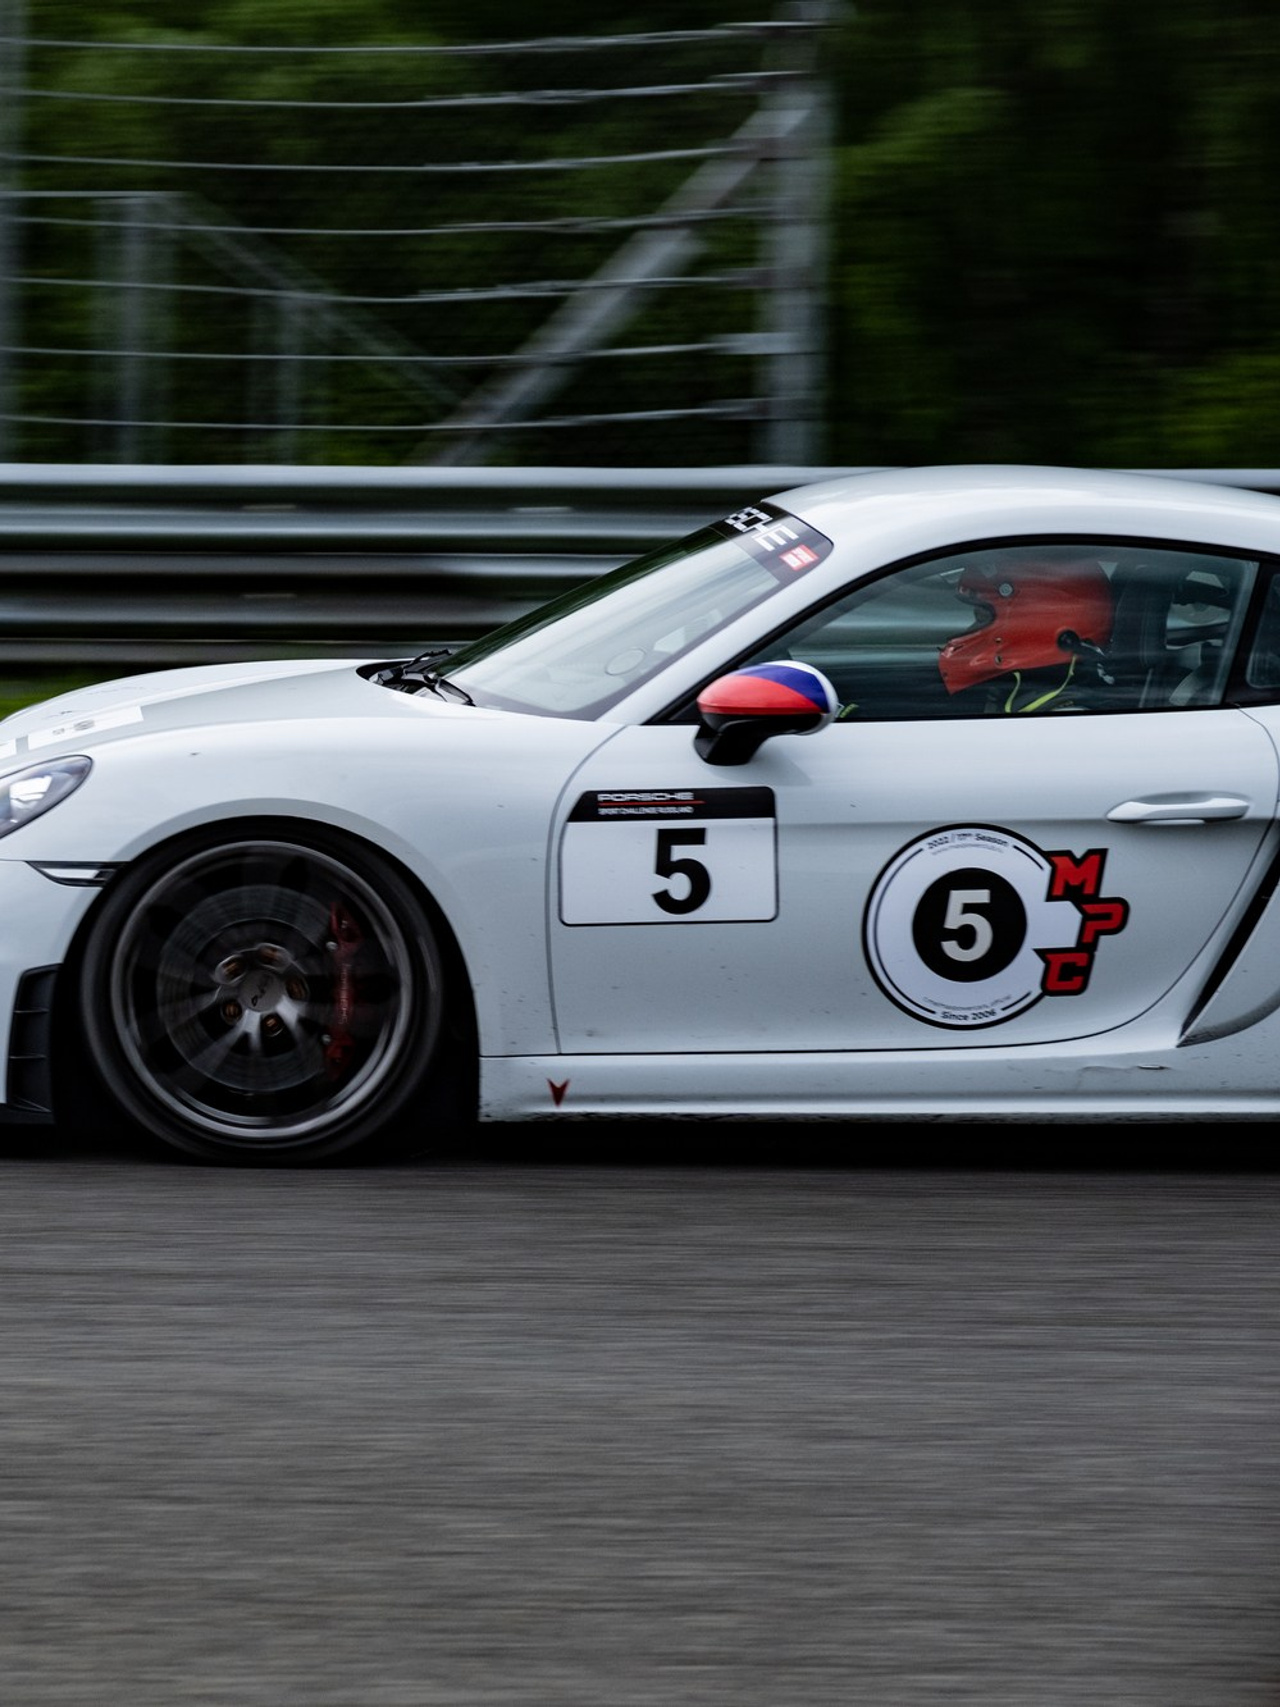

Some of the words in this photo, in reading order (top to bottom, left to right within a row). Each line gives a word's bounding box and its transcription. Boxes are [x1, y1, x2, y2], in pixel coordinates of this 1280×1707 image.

[598, 792, 694, 801] PORSCHE
[652, 828, 711, 915] 5
[940, 889, 993, 962] 5
[941, 1010, 969, 1022] Since
